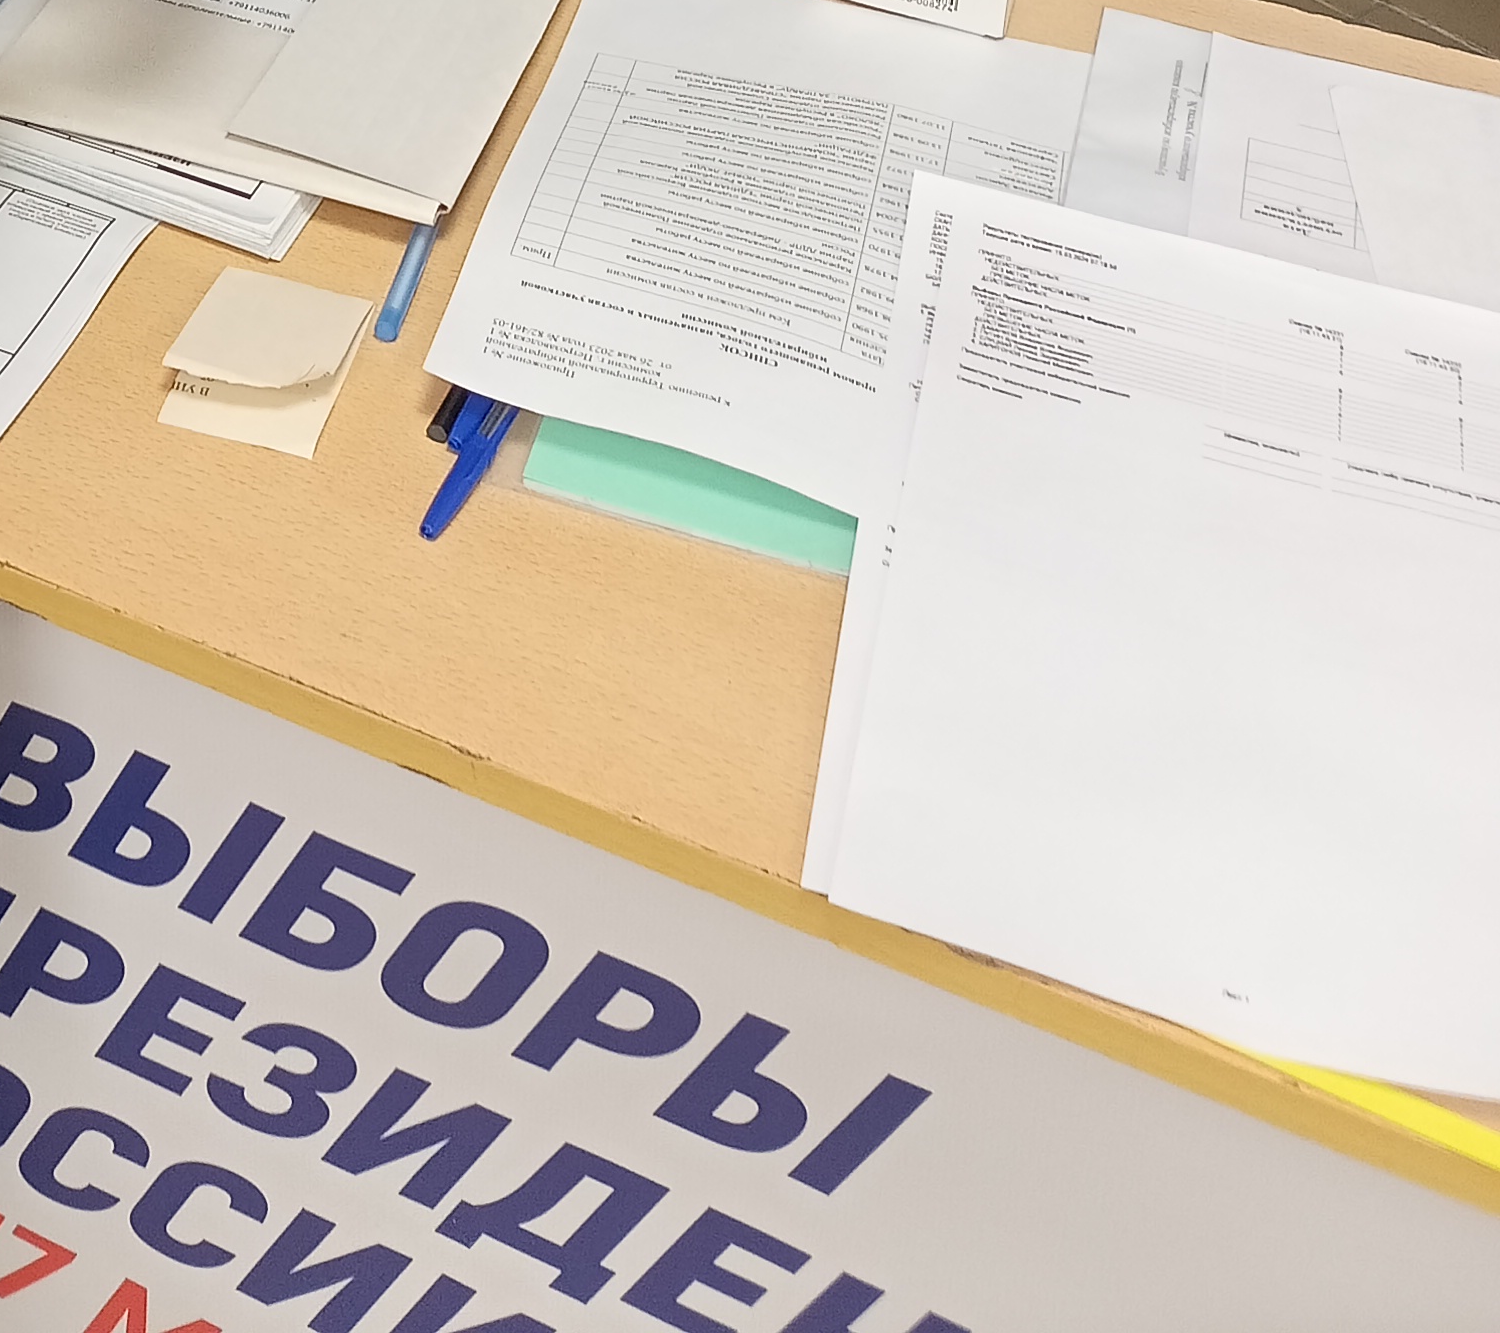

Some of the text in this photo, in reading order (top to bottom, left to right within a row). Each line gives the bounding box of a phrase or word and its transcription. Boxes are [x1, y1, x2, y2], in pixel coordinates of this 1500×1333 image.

[606, 268, 658, 287] комиссии
[521, 280, 585, 302] участковой
[660, 282, 695, 296] состав
[587, 298, 625, 312] состав
[706, 295, 766, 317] предложен
[638, 311, 713, 336] назначенных
[768, 313, 791, 327] Кем
[681, 313, 827, 363] избирательной комиссии
[716, 331, 758, 350] голоса,
[485, 336, 566, 364] избирательной
[720, 343, 778, 367] СПИСОК
[760, 346, 830, 375] решающего
[483, 345, 575, 379] Приложение № 1
[568, 359, 663, 390] Территориальной
[833, 371, 876, 393] правом
[668, 385, 722, 404] решению
